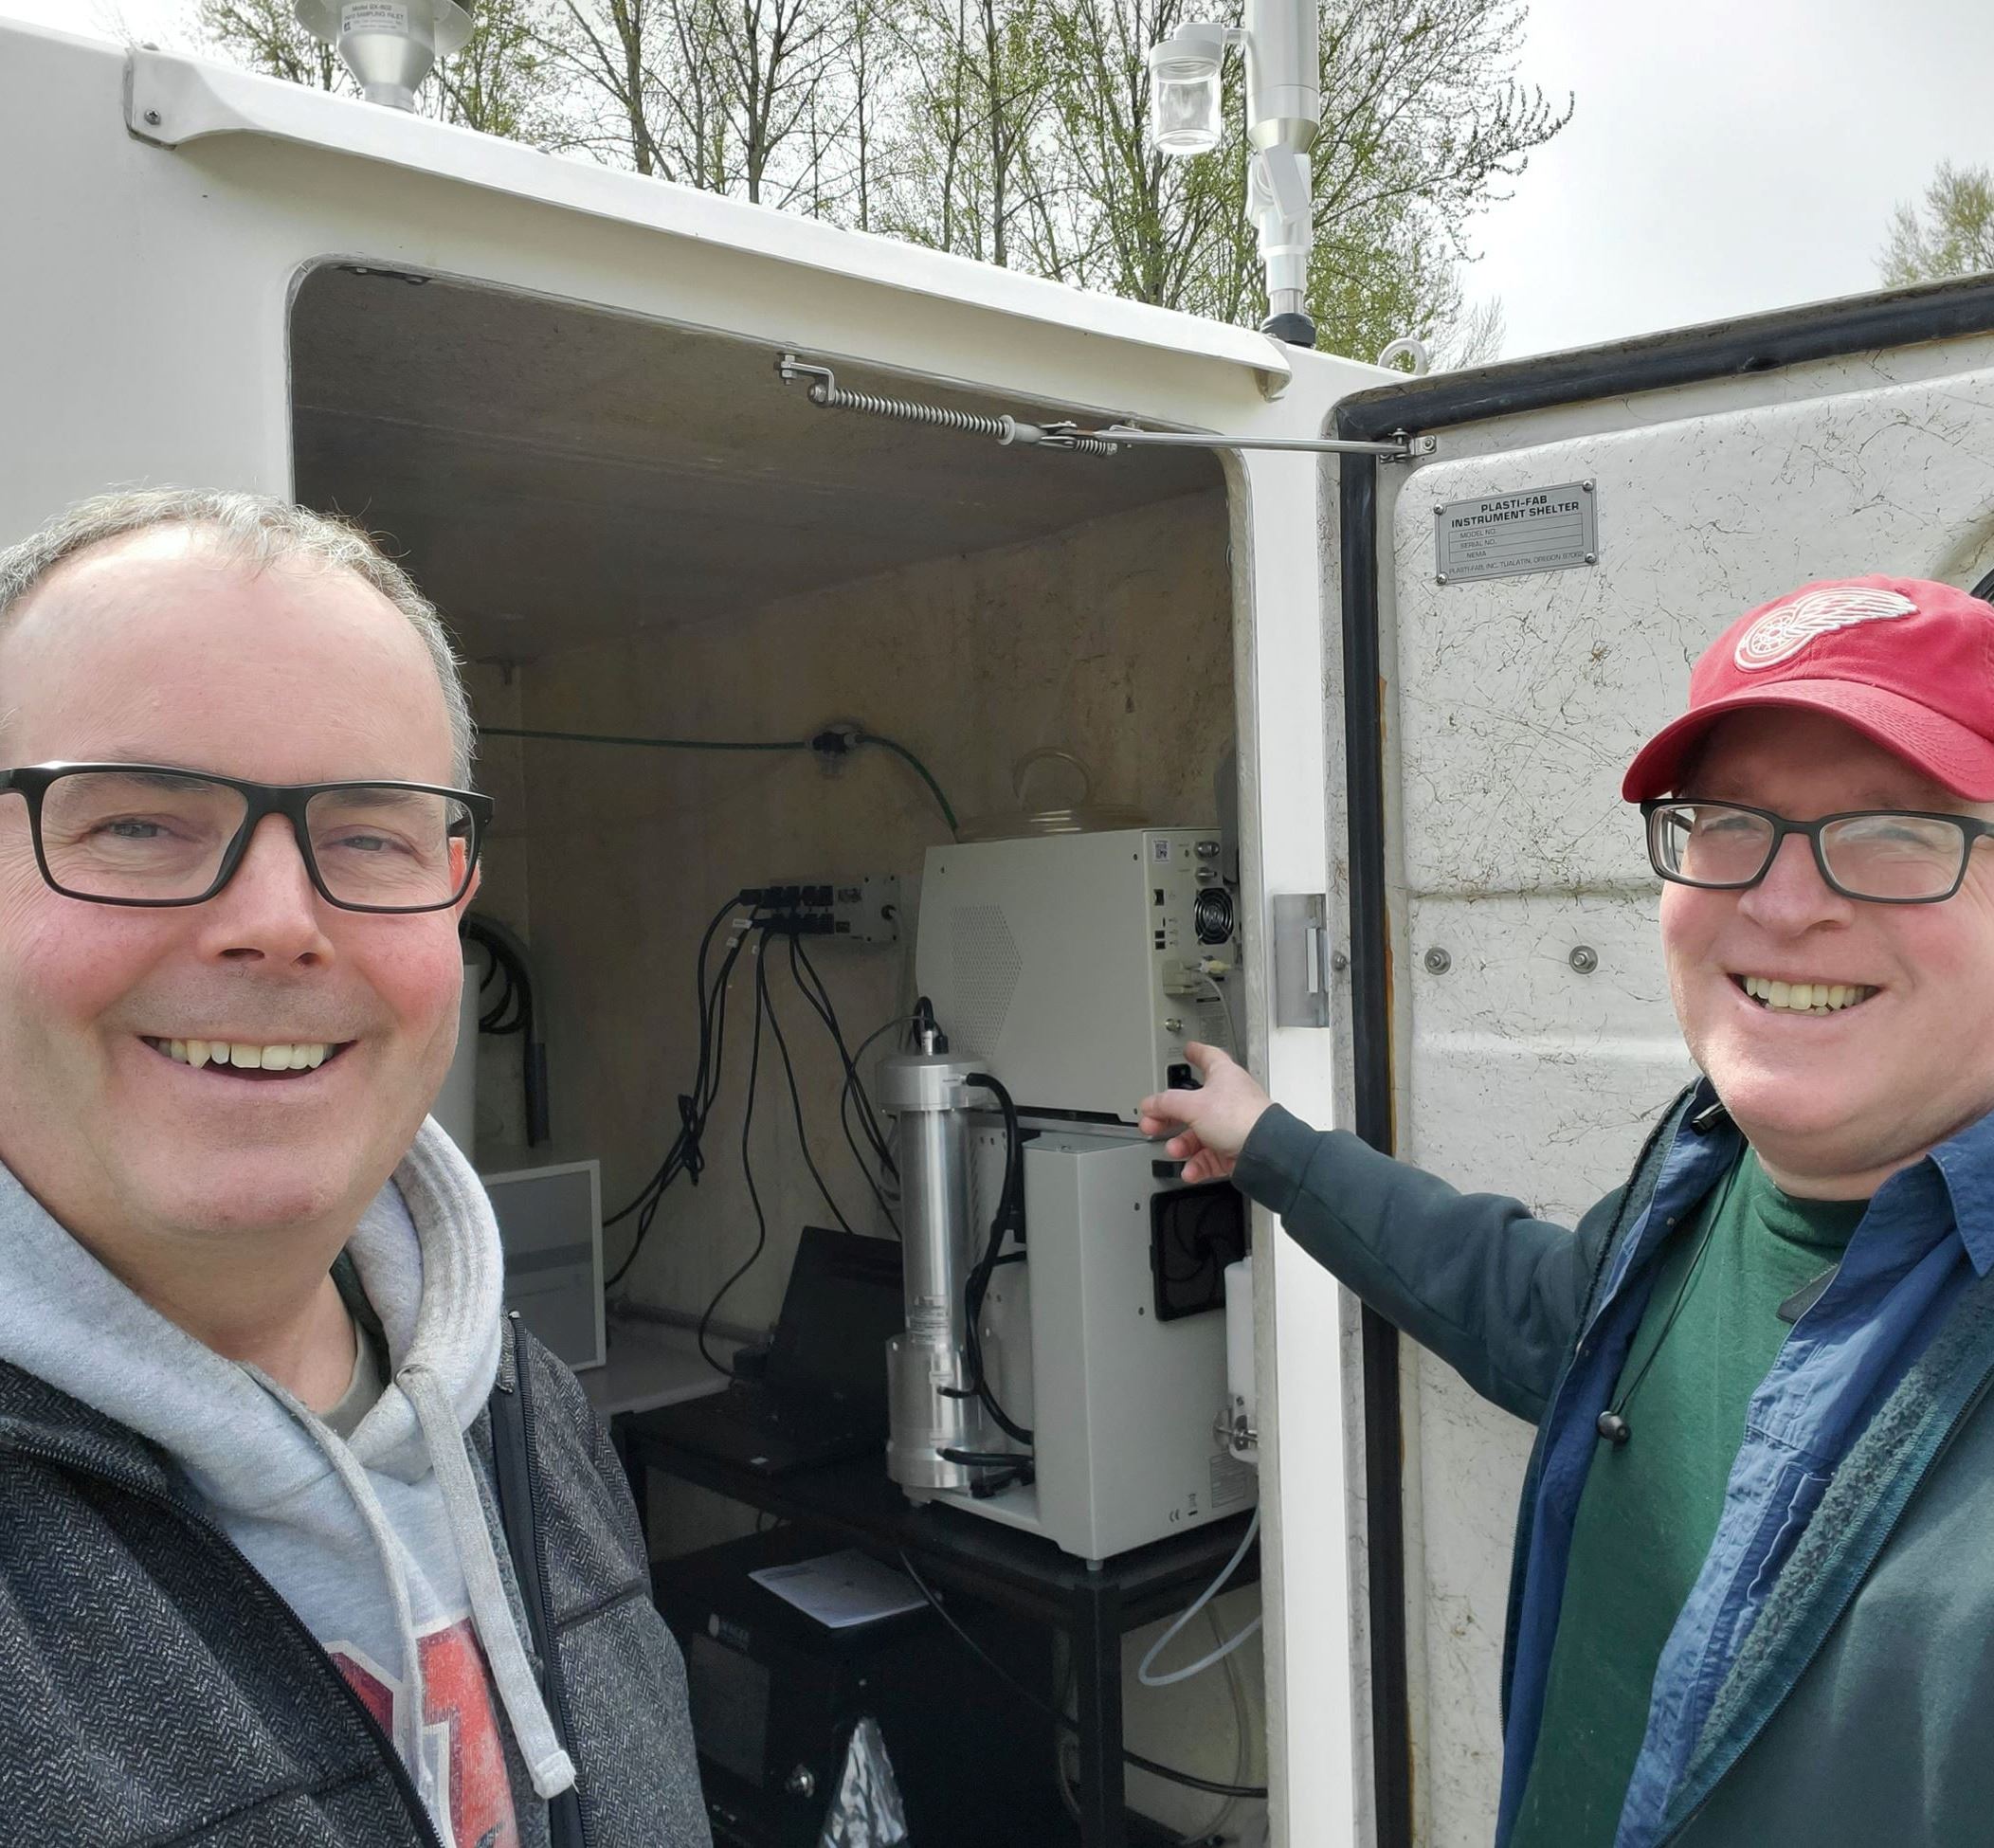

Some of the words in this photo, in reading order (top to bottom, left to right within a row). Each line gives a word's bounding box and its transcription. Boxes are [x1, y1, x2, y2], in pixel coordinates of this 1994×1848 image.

[1481, 495, 1548, 513] PLASTI-FAB
[1451, 509, 1525, 528] INSTRUMENT
[1529, 501, 1580, 516] SHELTER
[1459, 530, 1484, 539] MODEL
[1459, 540, 1484, 550] SERIAL
[1466, 550, 1487, 559] NEMA
